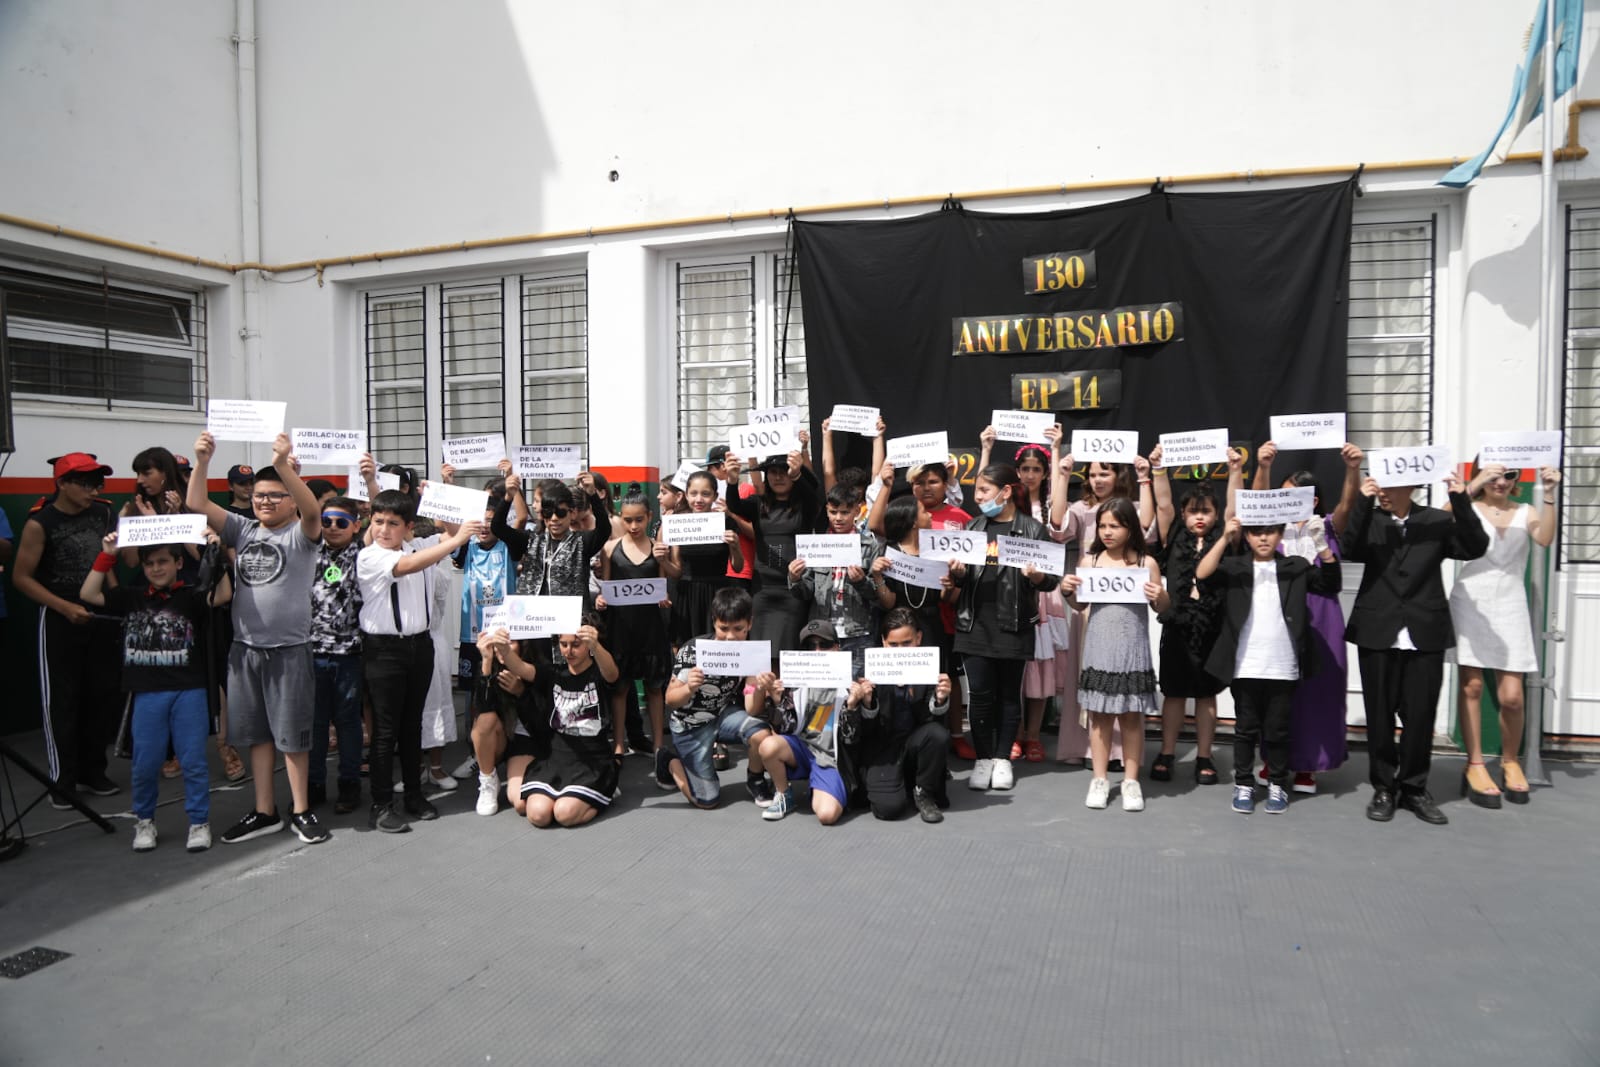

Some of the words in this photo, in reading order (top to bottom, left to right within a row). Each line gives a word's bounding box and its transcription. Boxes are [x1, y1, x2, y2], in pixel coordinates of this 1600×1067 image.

[1034, 255, 1086, 292] 130
[958, 308, 1175, 353] ANIVERSARIO
[1019, 378, 1059, 411] EP
[1071, 376, 1101, 410] 14
[348, 432, 360, 440] DE
[739, 430, 781, 448] 1900
[997, 430, 1029, 439] GENERAL
[1163, 436, 1197, 445] PRIMERA
[296, 442, 320, 450] AMAS
[321, 442, 333, 450] DE
[1082, 437, 1125, 454] 1930
[1497, 445, 1552, 453] CORDOBAZO
[460, 447, 486, 455] RACING
[450, 457, 469, 465] CLUB
[1176, 455, 1201, 463] RADIO
[1383, 454, 1435, 475] 1940
[1260, 500, 1303, 510] MALVINAS
[128, 517, 172, 525] PRIMERA
[668, 535, 722, 543] INDEPENDIENTE
[930, 535, 974, 554] 1950
[1005, 540, 1041, 550] MUJERES
[1005, 548, 1031, 557] VOTAN
[1040, 562, 1054, 571] VEZ
[1089, 576, 1136, 593] 1960
[612, 583, 655, 598] 1920
[525, 614, 556, 622] Gracias
[124, 648, 190, 667] FORTNITE
[702, 661, 728, 669] COVID
[730, 661, 740, 669] 19
